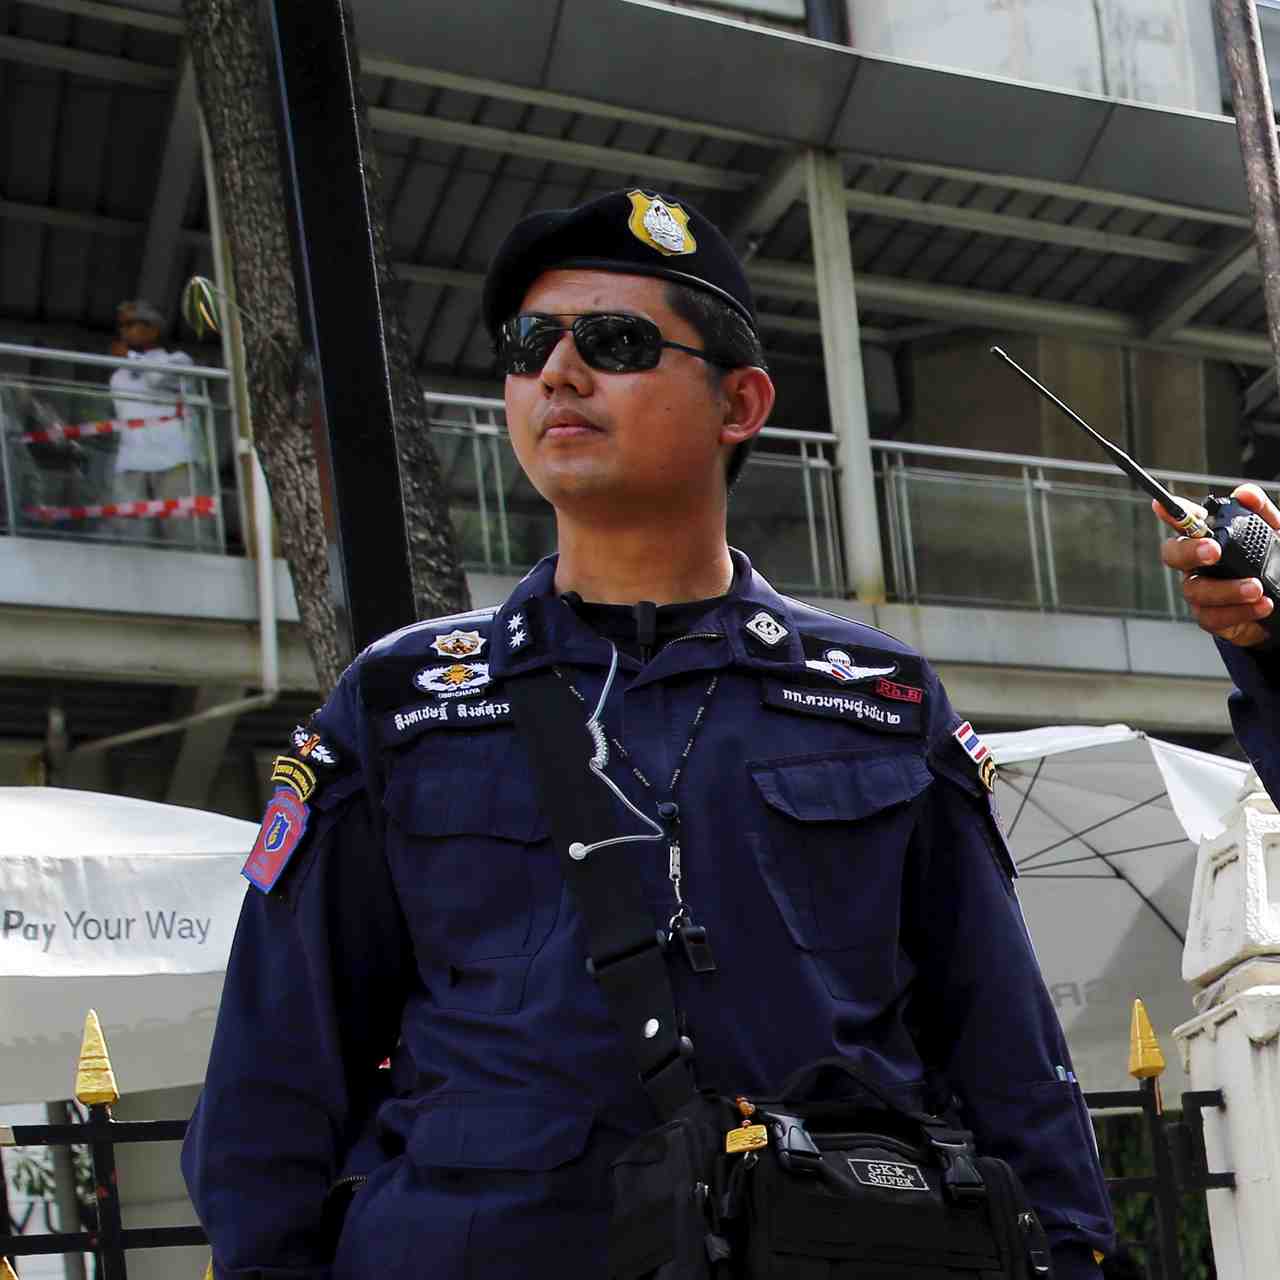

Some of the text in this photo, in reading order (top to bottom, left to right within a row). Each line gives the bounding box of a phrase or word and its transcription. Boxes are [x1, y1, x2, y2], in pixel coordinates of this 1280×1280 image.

[2, 909, 212, 953] Pay Your Way
